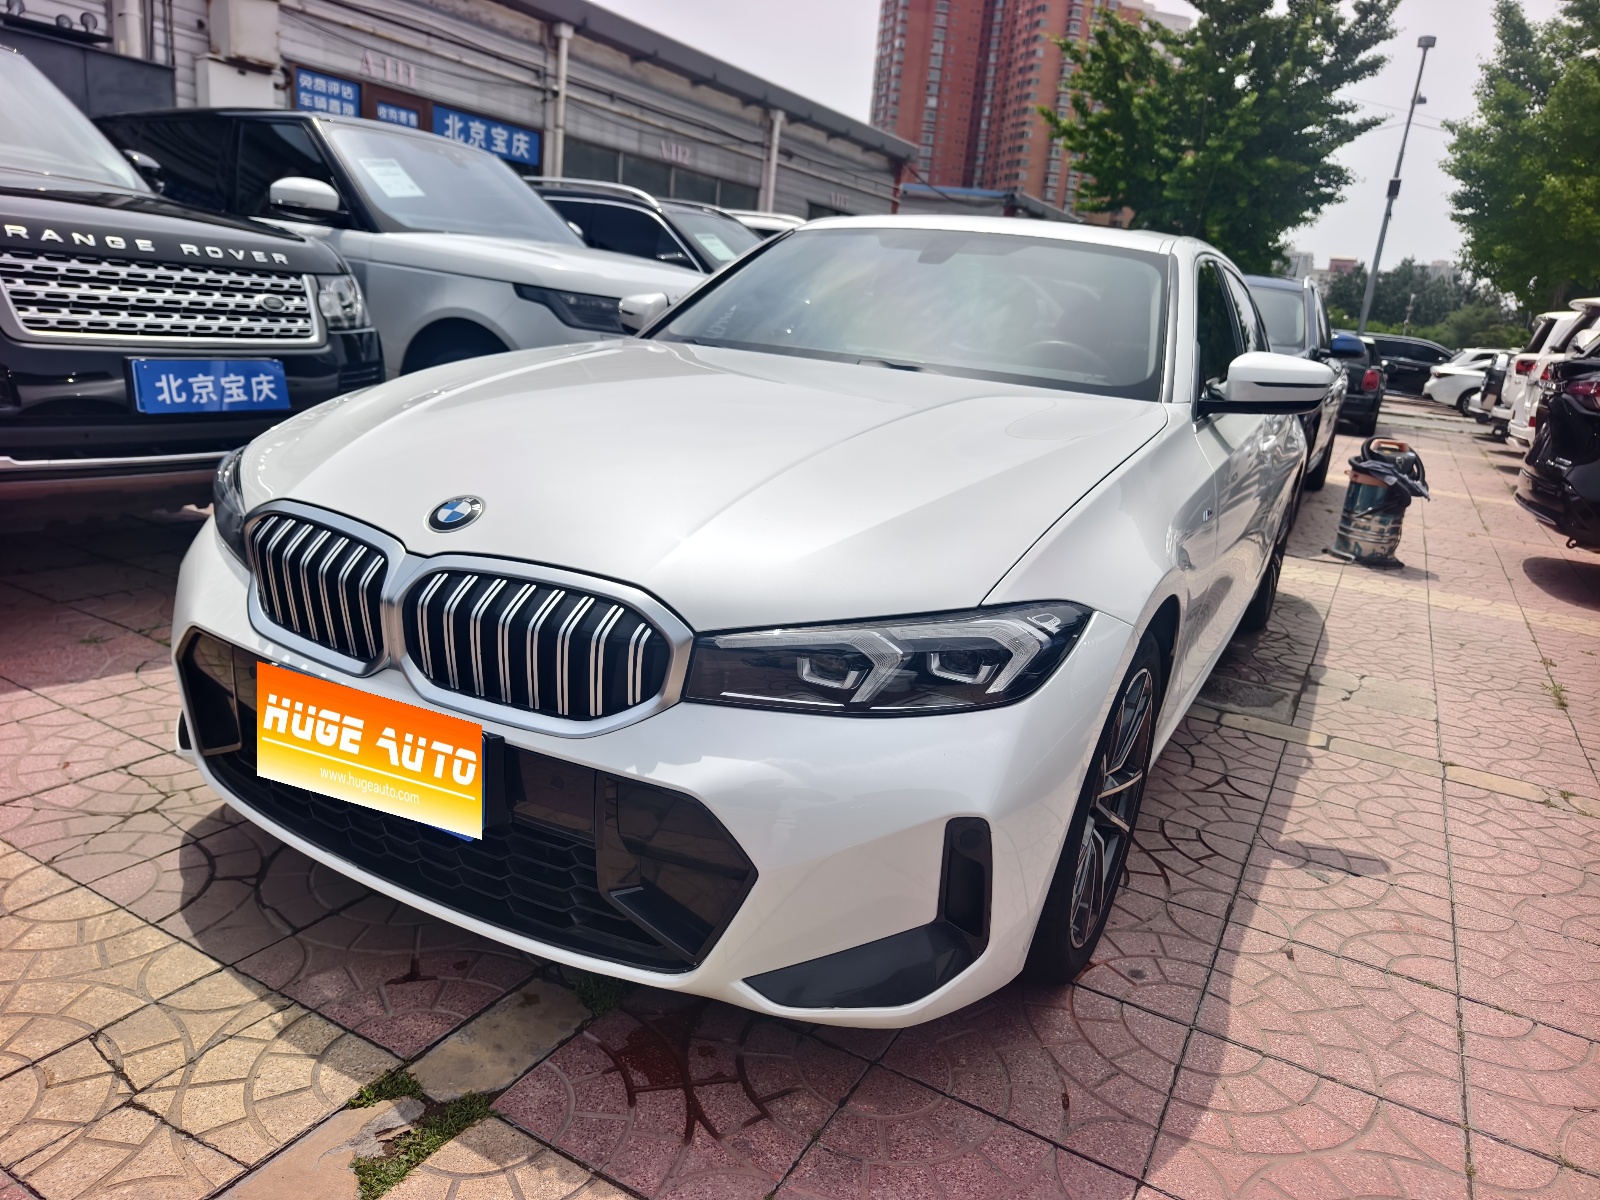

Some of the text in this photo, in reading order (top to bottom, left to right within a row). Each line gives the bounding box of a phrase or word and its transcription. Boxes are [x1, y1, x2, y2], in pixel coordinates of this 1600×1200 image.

[443, 113, 530, 159] 北京宝庆
[4, 224, 289, 266] RANGE ROVER
[154, 372, 279, 406] 北京宝庆
